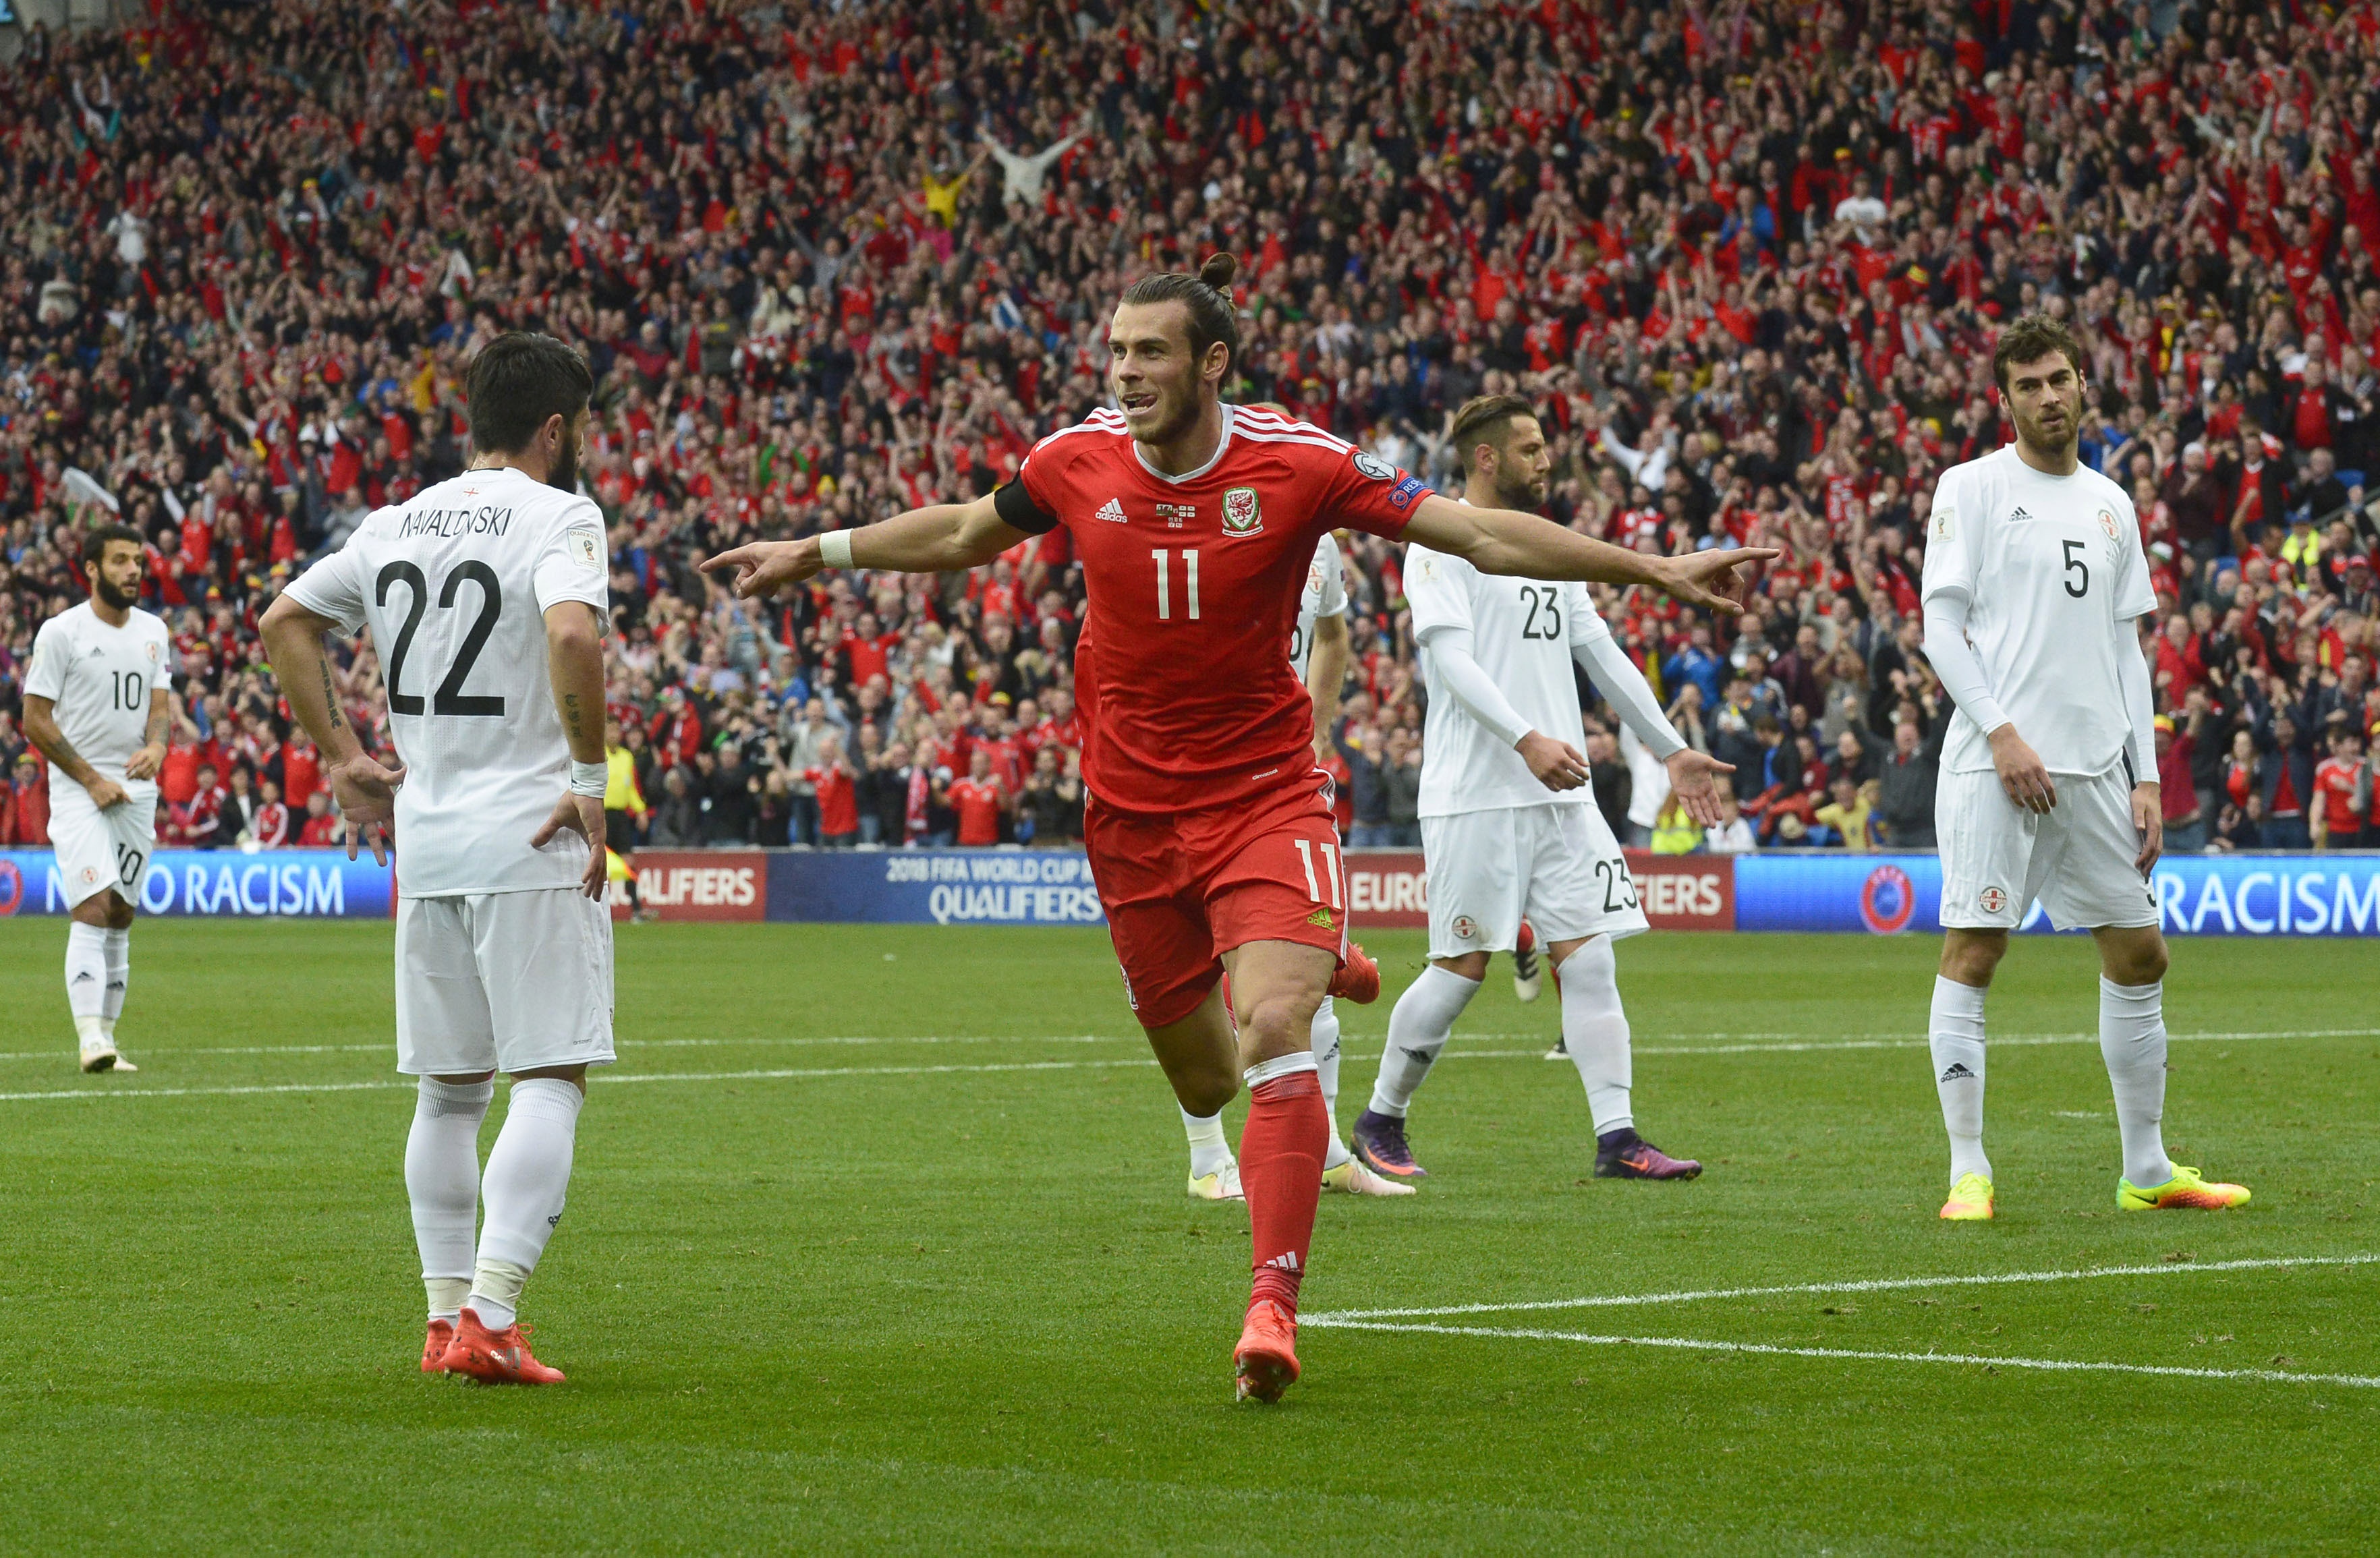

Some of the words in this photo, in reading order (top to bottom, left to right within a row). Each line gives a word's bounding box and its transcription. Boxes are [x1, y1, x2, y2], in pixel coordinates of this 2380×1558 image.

[1403, 480, 1423, 493] RES
[399, 506, 512, 538] NAVALOVSKI
[1095, 511, 1127, 523] adidas
[1152, 549, 1199, 619] 11
[2062, 540, 2089, 598] 5
[1520, 585, 1560, 640] 23
[376, 560, 505, 716] 22
[112, 671, 142, 710] 10
[118, 843, 142, 885] 10
[886, 857, 929, 882] 2018
[930, 857, 970, 882] FIFA
[970, 857, 1039, 883] WORLD
[1040, 858, 1079, 884] CUP
[1295, 839, 1342, 909] 11
[184, 864, 345, 915] RACISM
[609, 868, 756, 906] ALIFIERS
[929, 884, 1102, 925] QUALIFIERS
[1595, 858, 1637, 913] 23
[2157, 873, 2380, 933] RACISM
[1307, 917, 1336, 932] adidas
[1940, 1071, 1974, 1083] adidas
